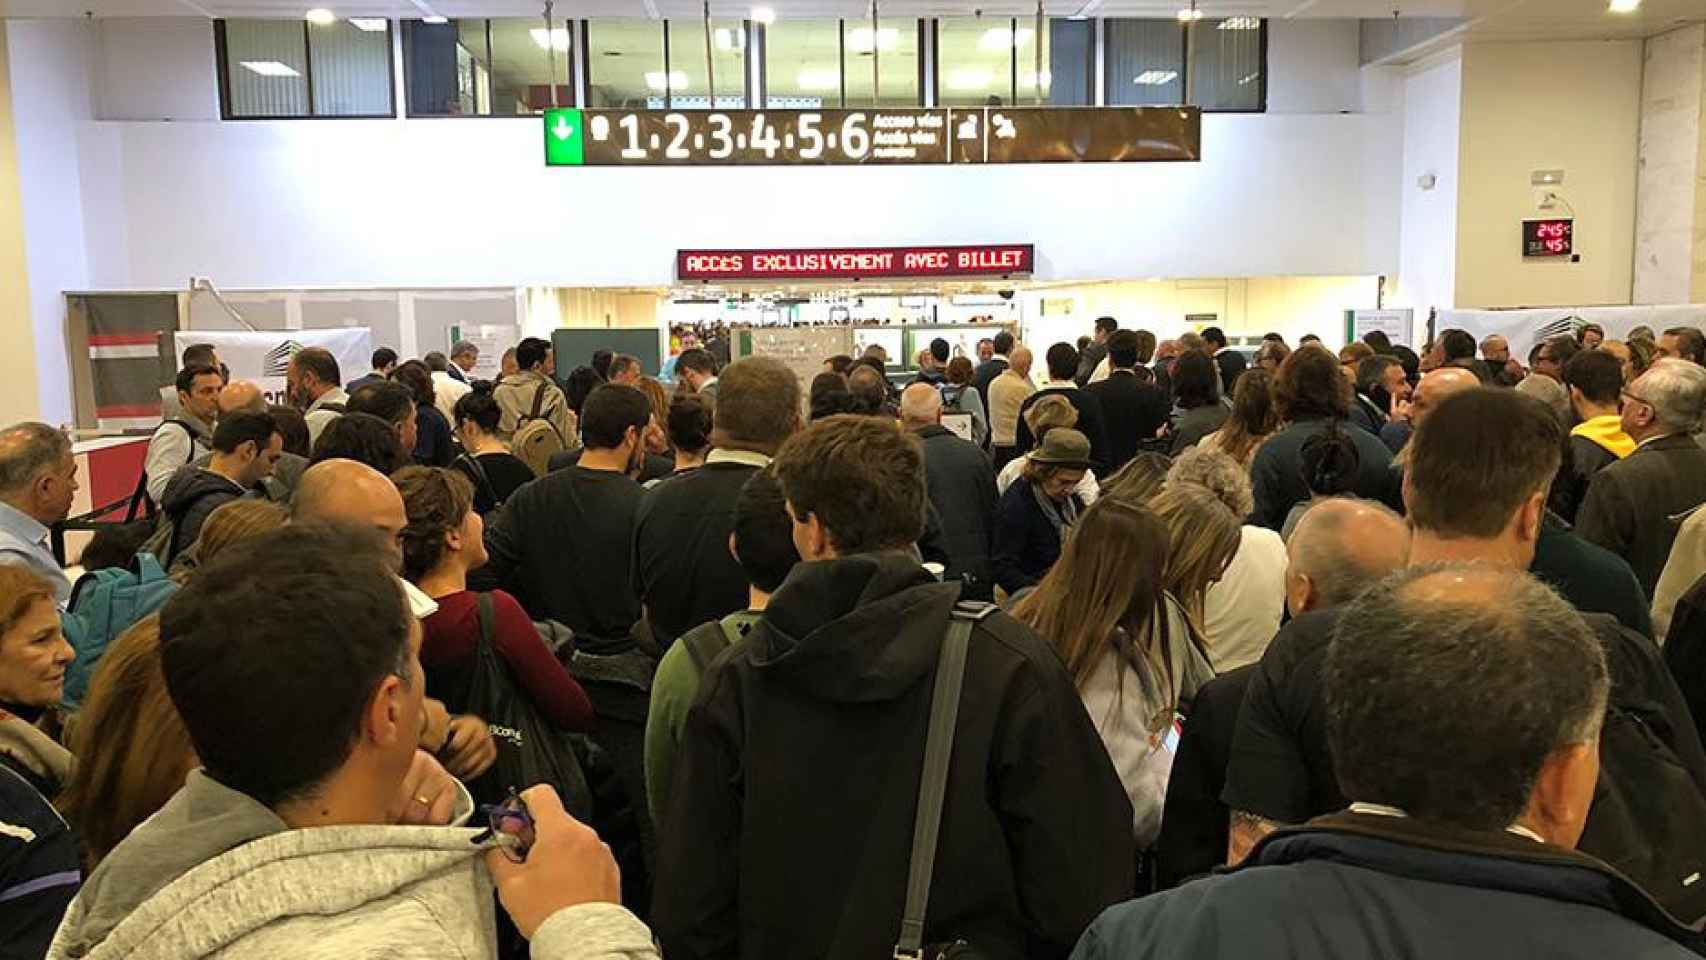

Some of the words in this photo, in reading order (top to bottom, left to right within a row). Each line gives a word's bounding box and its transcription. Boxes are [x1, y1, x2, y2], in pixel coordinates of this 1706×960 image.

[752, 253, 894, 270] EXCLUSIVEMENT
[904, 252, 949, 268] AVEC
[957, 250, 1023, 268] BILLET
